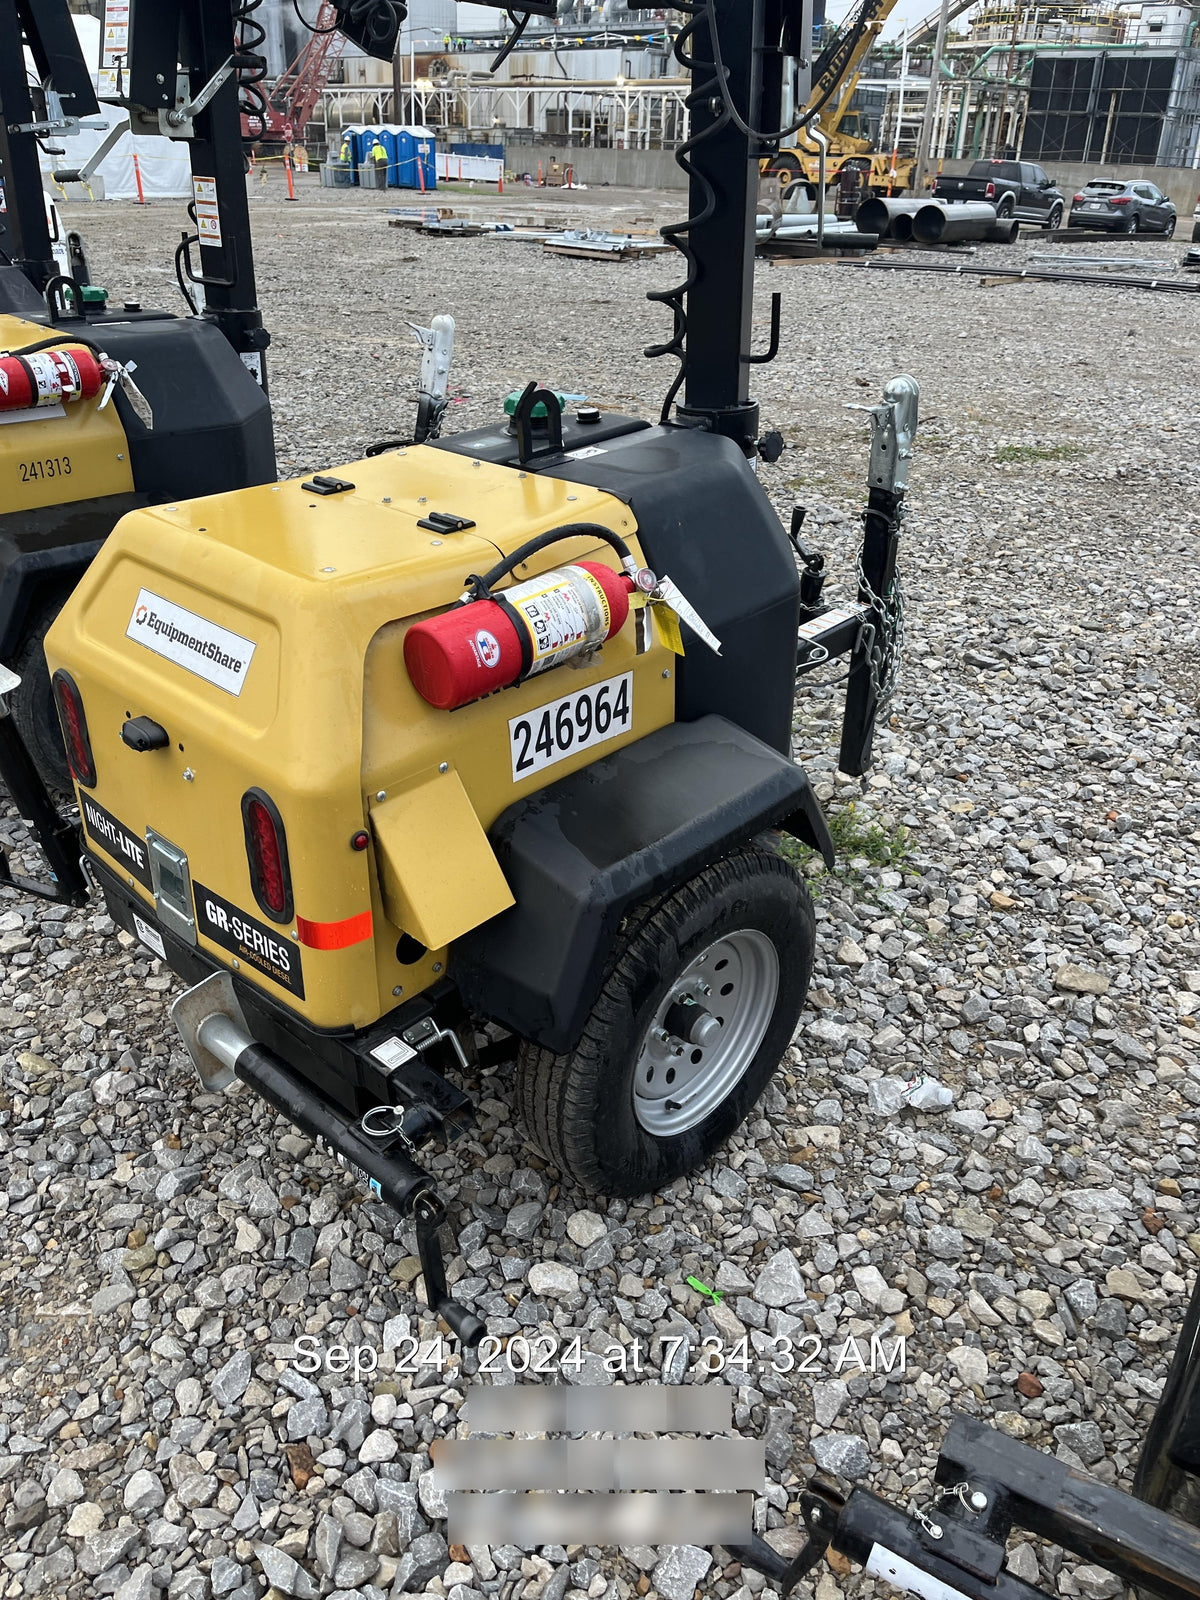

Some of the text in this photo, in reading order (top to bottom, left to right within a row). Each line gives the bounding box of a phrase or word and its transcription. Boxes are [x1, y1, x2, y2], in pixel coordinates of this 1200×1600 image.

[19, 456, 72, 482] 241313
[587, 575, 610, 627] INSTRUCTIONS
[147, 611, 242, 674] EquipmentShare
[513, 678, 629, 773] 246964
[85, 802, 145, 870] NIGHT-LITE
[205, 899, 290, 971] GR-SERIES
[238, 944, 292, 985] AIR-COOLED DIESEL
